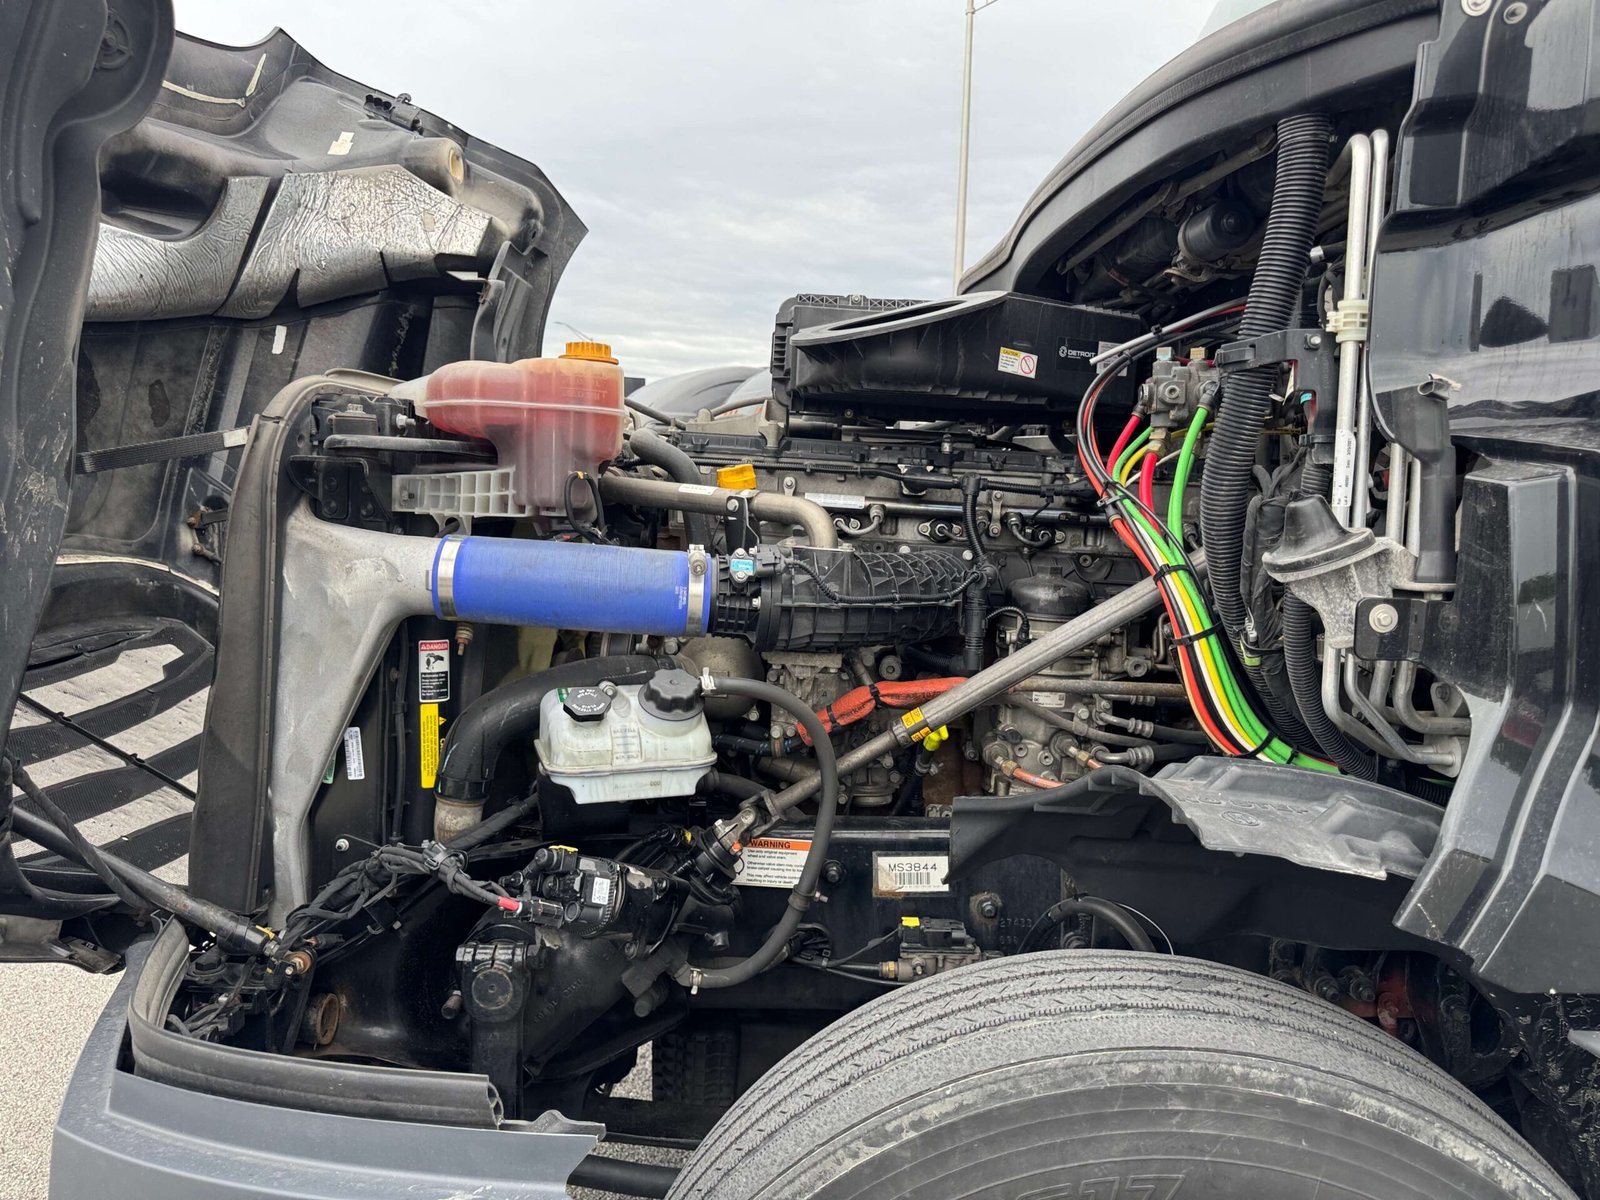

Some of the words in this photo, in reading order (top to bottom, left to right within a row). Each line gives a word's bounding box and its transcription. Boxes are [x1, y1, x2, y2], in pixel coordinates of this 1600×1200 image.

[1067, 350, 1095, 358] DETROIT
[427, 642, 448, 650] DANGER
[750, 840, 791, 849] WARNING
[888, 862, 937, 872] MS3844
